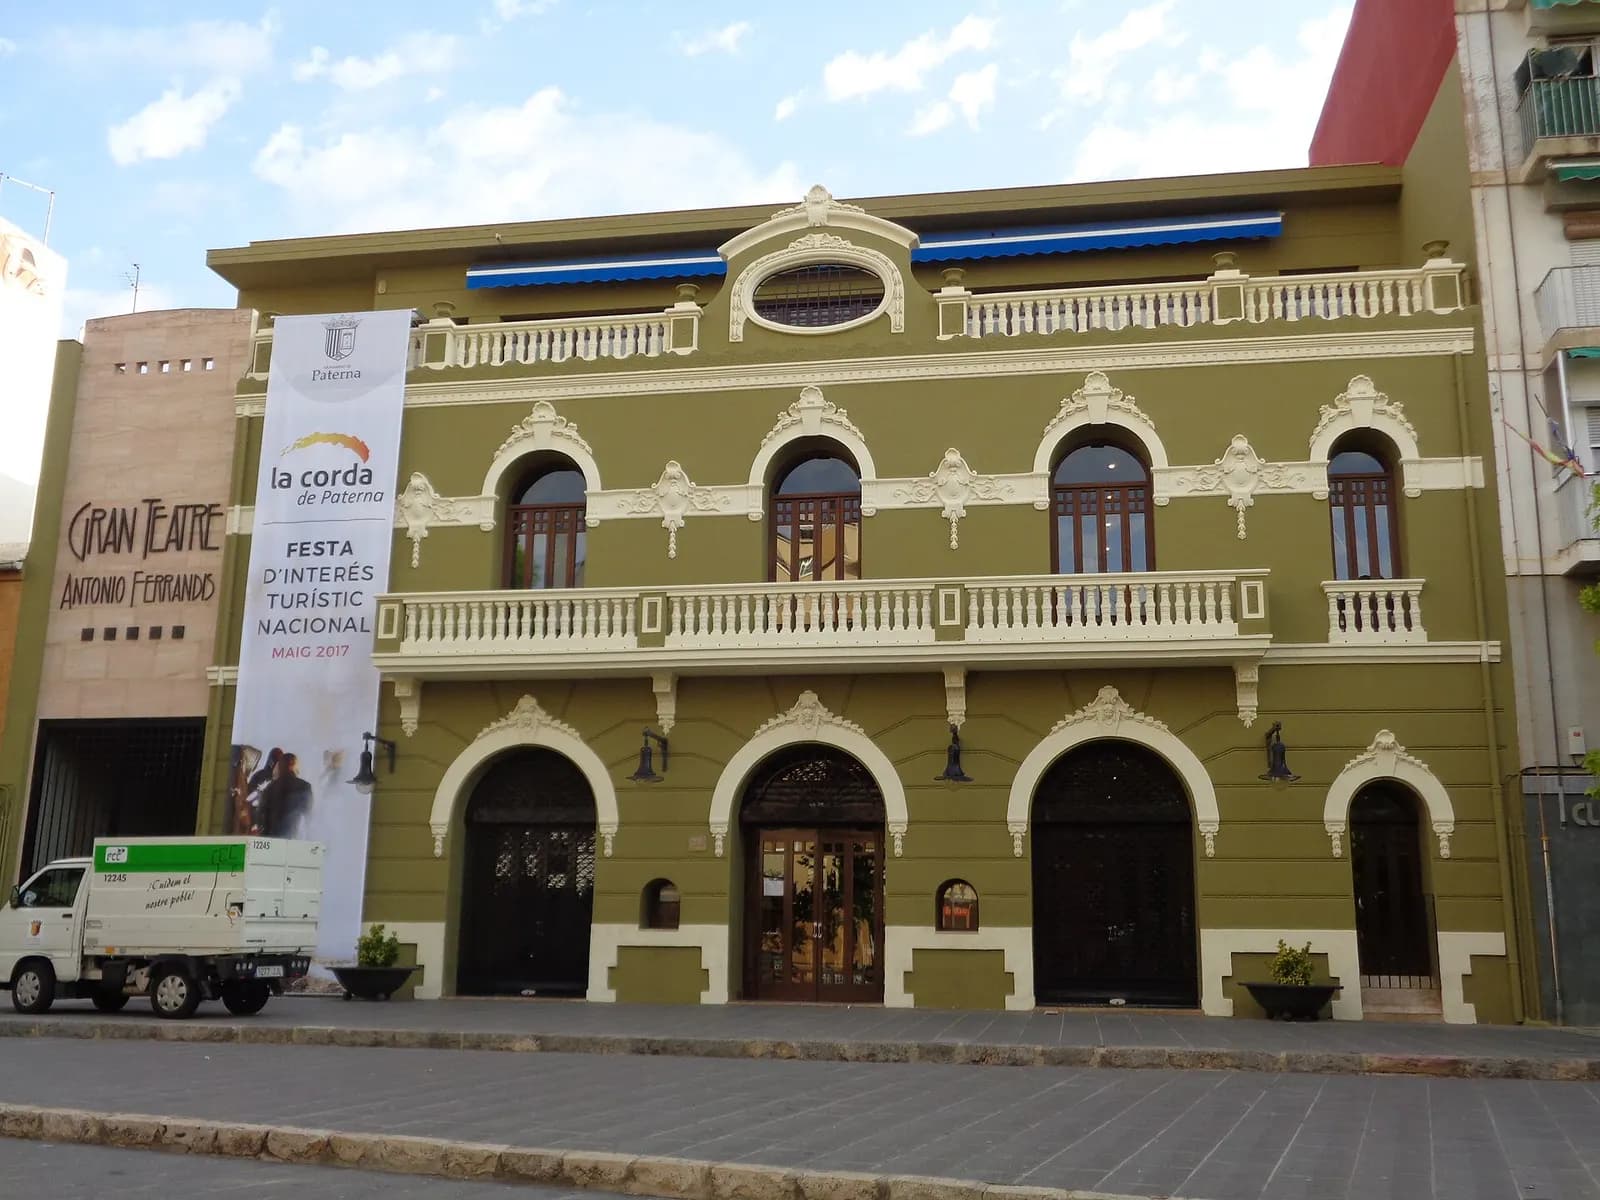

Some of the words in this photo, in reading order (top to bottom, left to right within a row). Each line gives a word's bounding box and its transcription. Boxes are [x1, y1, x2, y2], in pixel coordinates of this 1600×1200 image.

[312, 369, 361, 381] Paterna
[271, 466, 292, 489] la
[300, 463, 373, 488] corda
[297, 490, 316, 505] de
[321, 490, 384, 505] Paterna
[68, 502, 137, 562] GRAN
[142, 499, 224, 560] TEATRE
[287, 540, 353, 558] FESTA
[263, 561, 374, 585] D'INTERÉS
[60, 573, 125, 610] ANTONIO
[130, 571, 215, 608] FERRANDIS
[267, 588, 363, 609] TURÍSTIC
[258, 617, 370, 636] NACIONAL
[272, 646, 311, 659] MAIG
[316, 645, 350, 658] 2017
[253, 839, 270, 850] 12245
[104, 873, 127, 883] 12245
